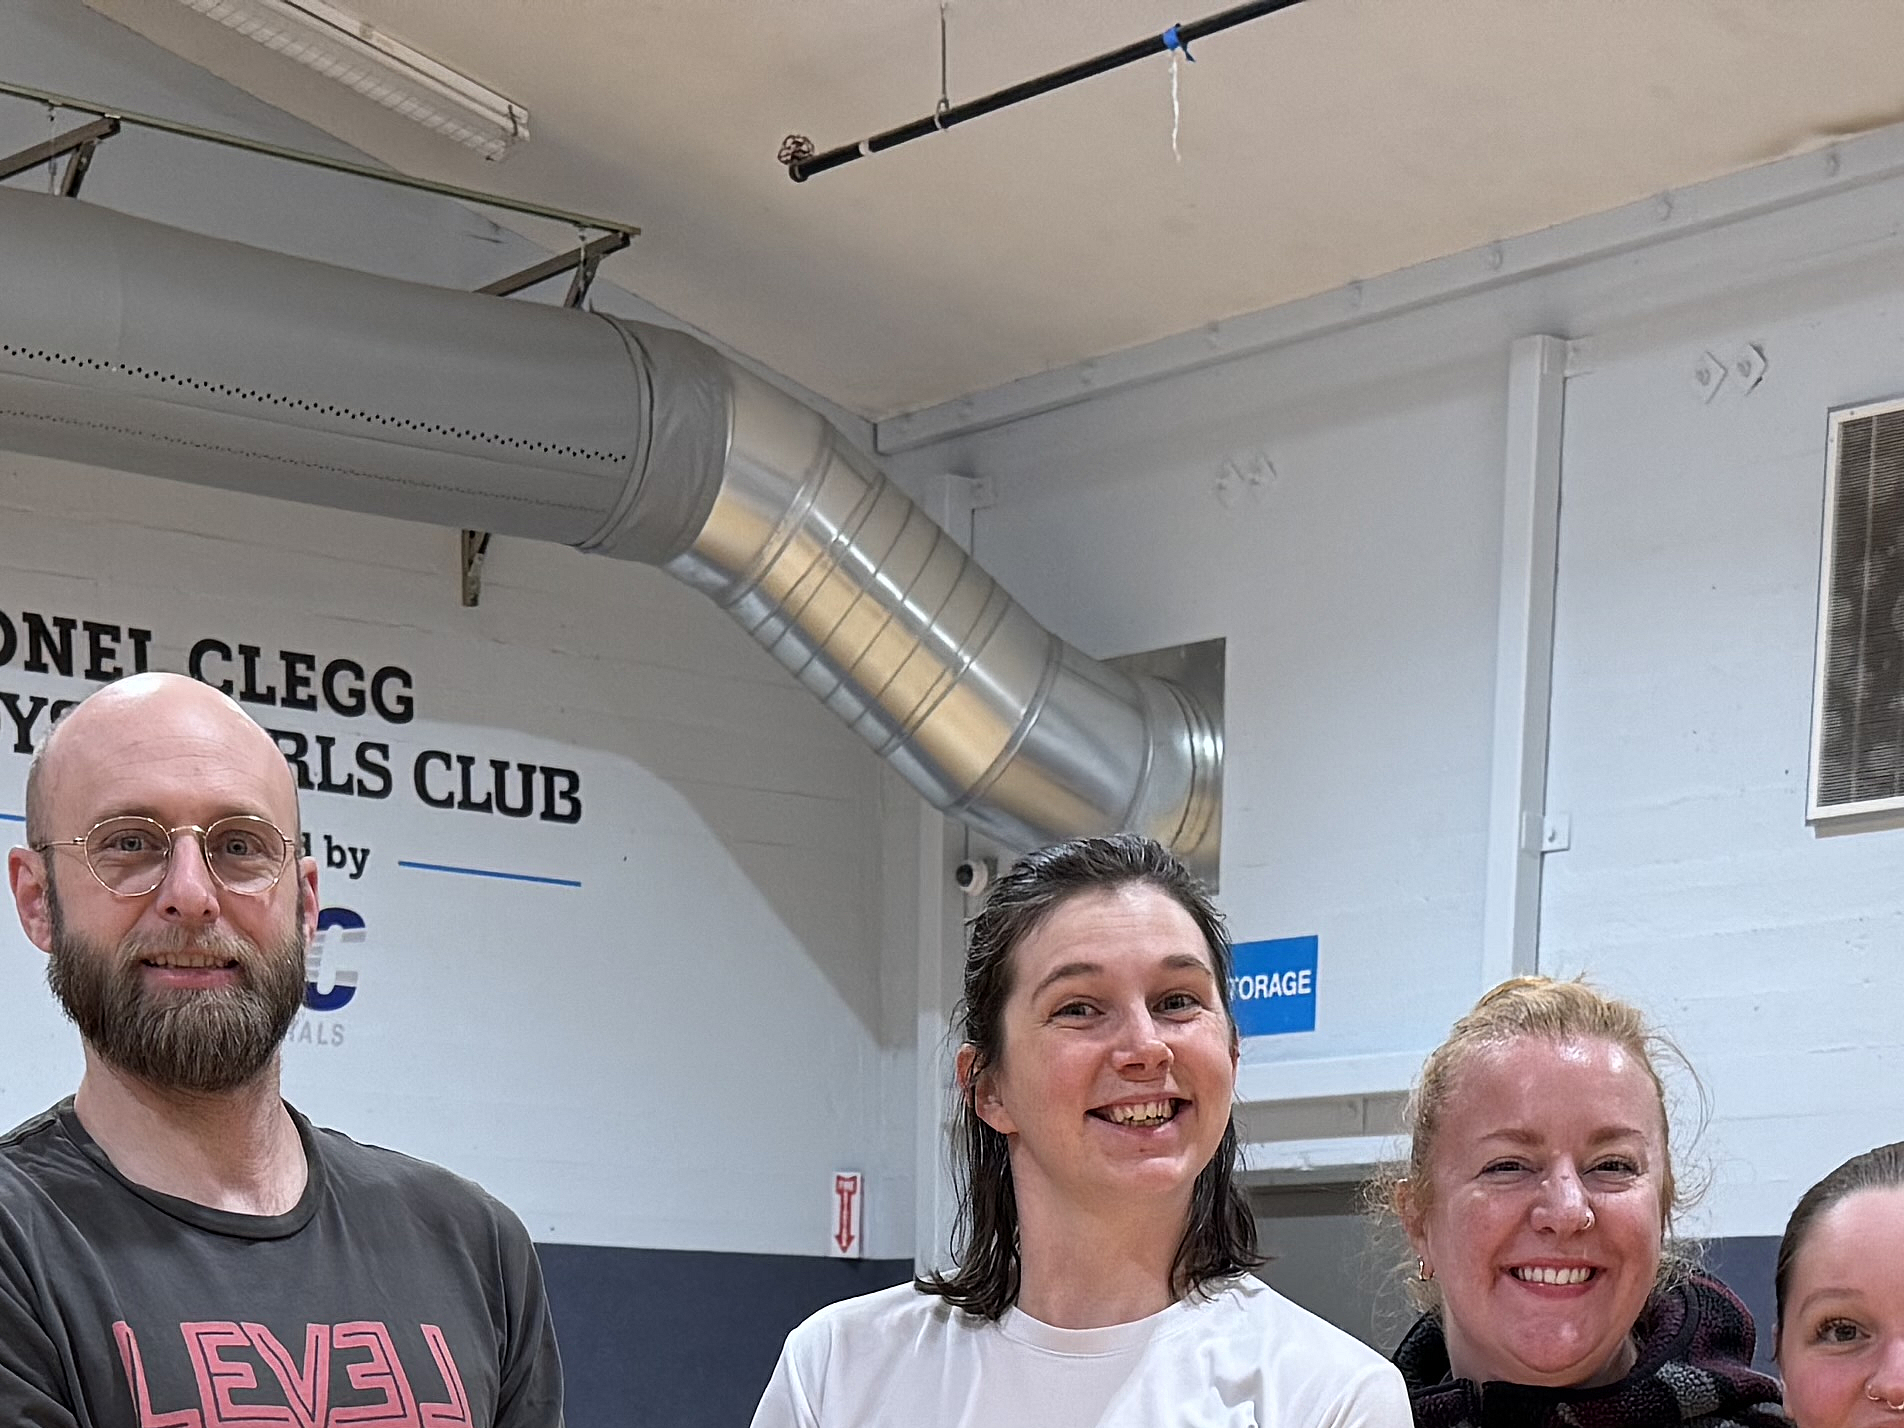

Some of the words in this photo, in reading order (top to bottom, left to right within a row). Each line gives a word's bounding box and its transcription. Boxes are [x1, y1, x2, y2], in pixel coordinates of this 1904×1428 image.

[189, 638, 415, 725] CLEGG
[266, 728, 393, 800] RLS
[413, 749, 583, 825] CLUB
[323, 834, 371, 880] by
[1229, 969, 1312, 1001] TORAGE
